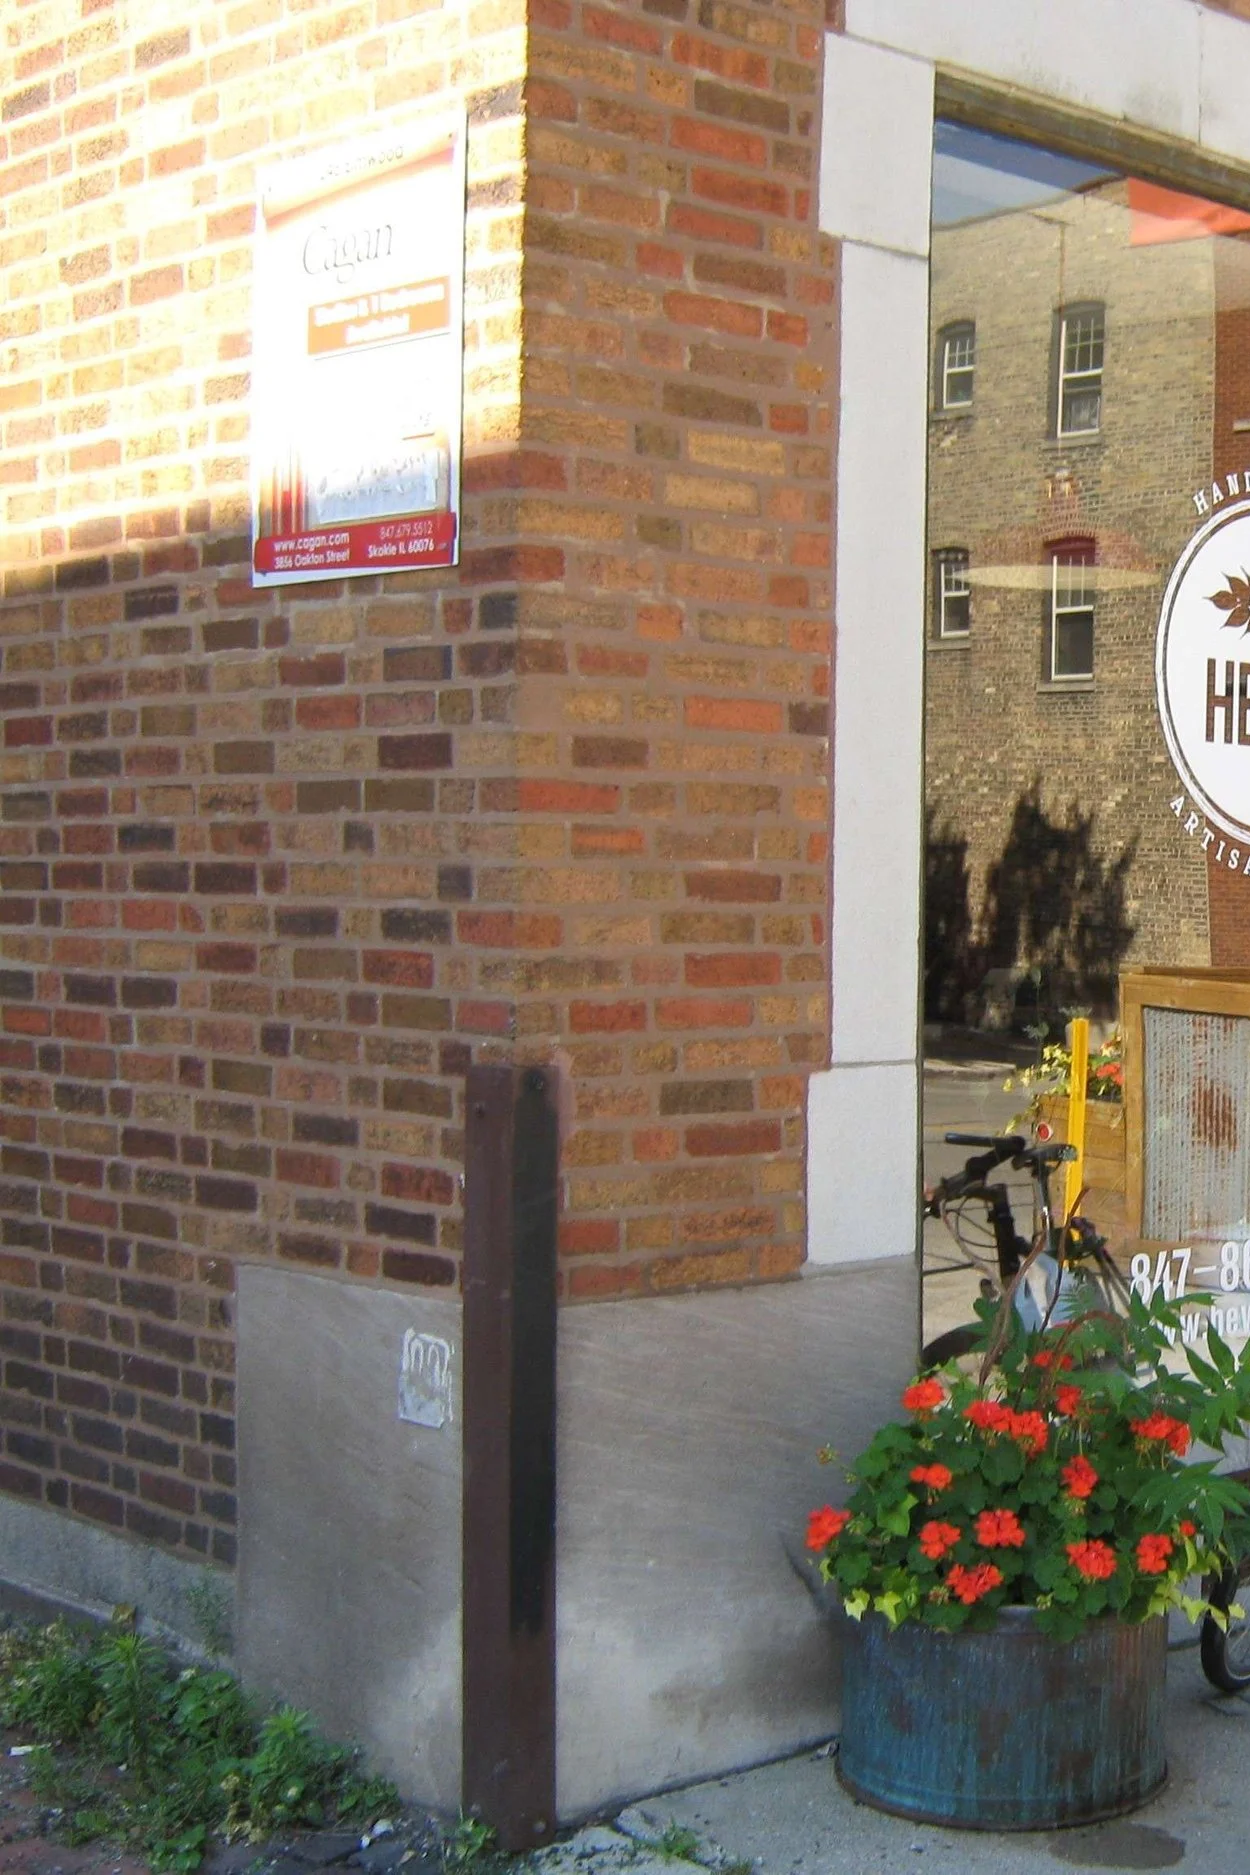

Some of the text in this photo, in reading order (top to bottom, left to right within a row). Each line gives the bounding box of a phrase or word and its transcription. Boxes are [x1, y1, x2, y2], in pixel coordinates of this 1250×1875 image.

[274, 532, 349, 552] www.cagan.com
[326, 548, 350, 564] Street
[368, 543, 397, 558] Skokie
